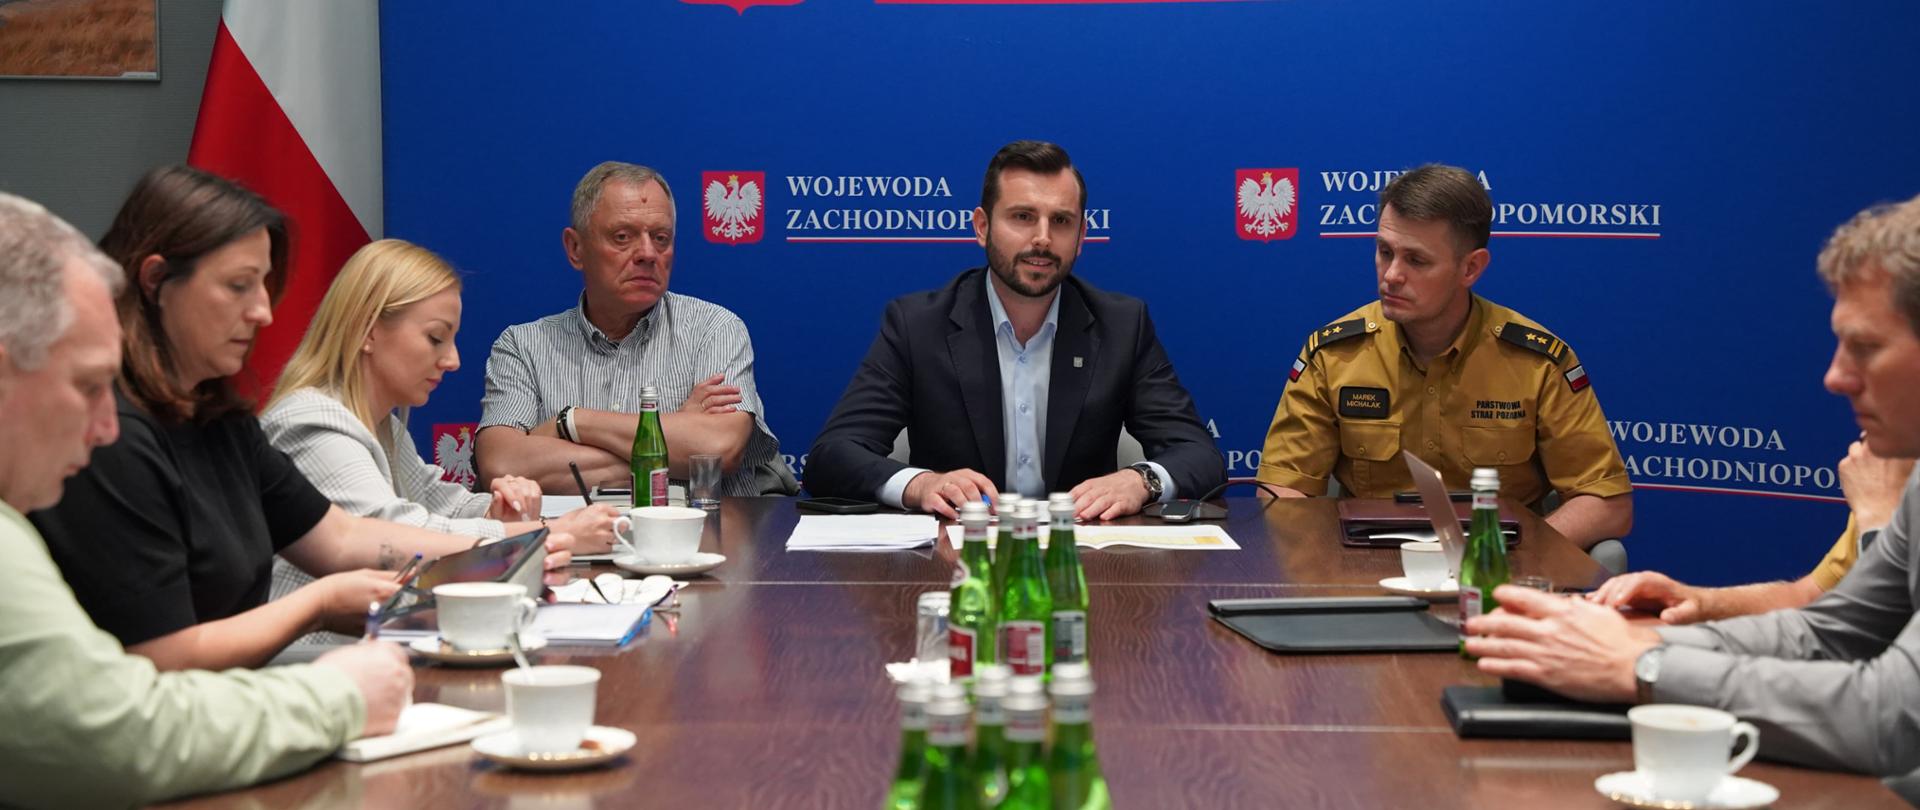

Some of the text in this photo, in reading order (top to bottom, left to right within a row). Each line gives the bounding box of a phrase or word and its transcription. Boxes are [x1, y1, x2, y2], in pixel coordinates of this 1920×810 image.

[786, 176, 952, 197] WOJEWODA
[786, 209, 1110, 230] ZACHODNIOPKI
[1319, 203, 1660, 226] ZACPOMORSKI
[1346, 400, 1381, 409] MICHALAK
[1352, 393, 1376, 401] MAREK
[1606, 420, 1787, 451] WOJEWODA
[1625, 454, 1842, 490] ACHODNIOPO
